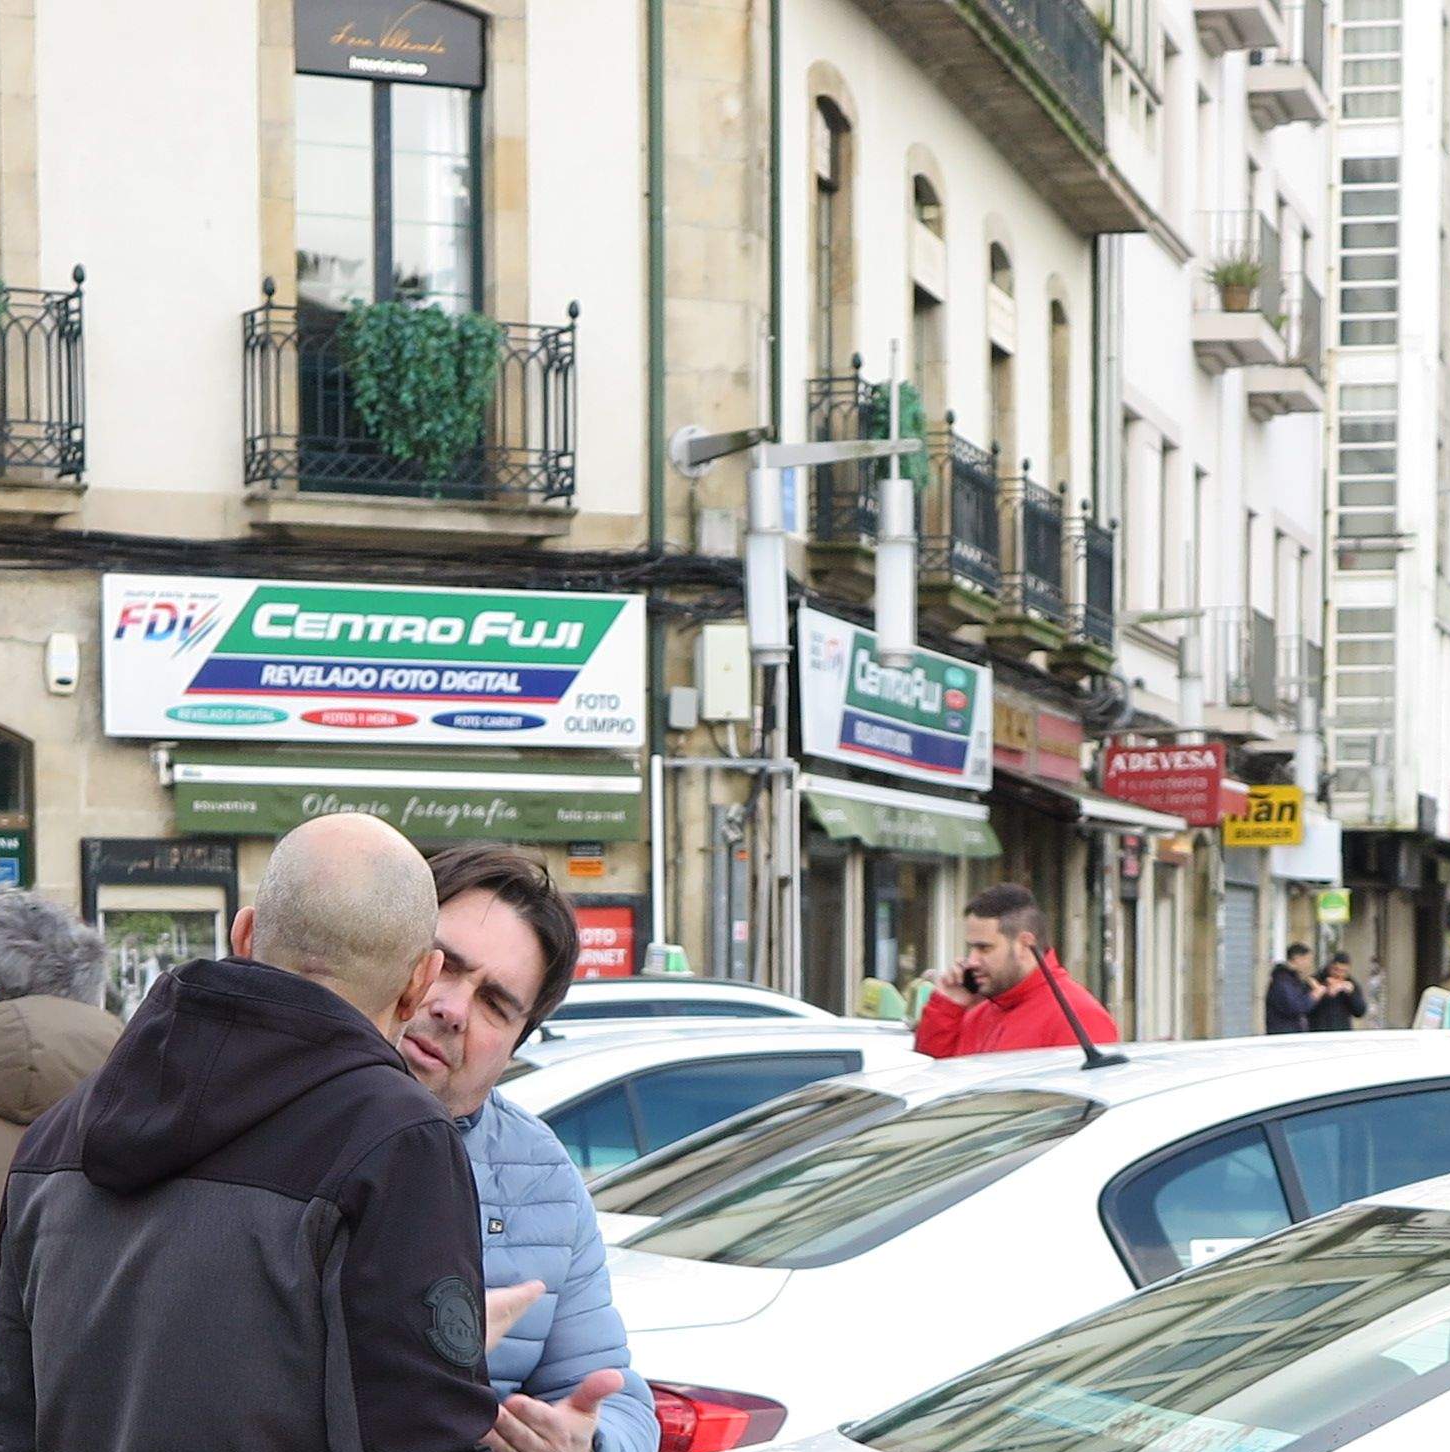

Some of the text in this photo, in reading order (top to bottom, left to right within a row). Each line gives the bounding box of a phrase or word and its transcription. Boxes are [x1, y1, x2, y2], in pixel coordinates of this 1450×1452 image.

[261, 664, 521, 693] REVELADO FOTO DIGITAL
[575, 694, 621, 711] FOTO
[564, 716, 635, 734] OLIMPIO
